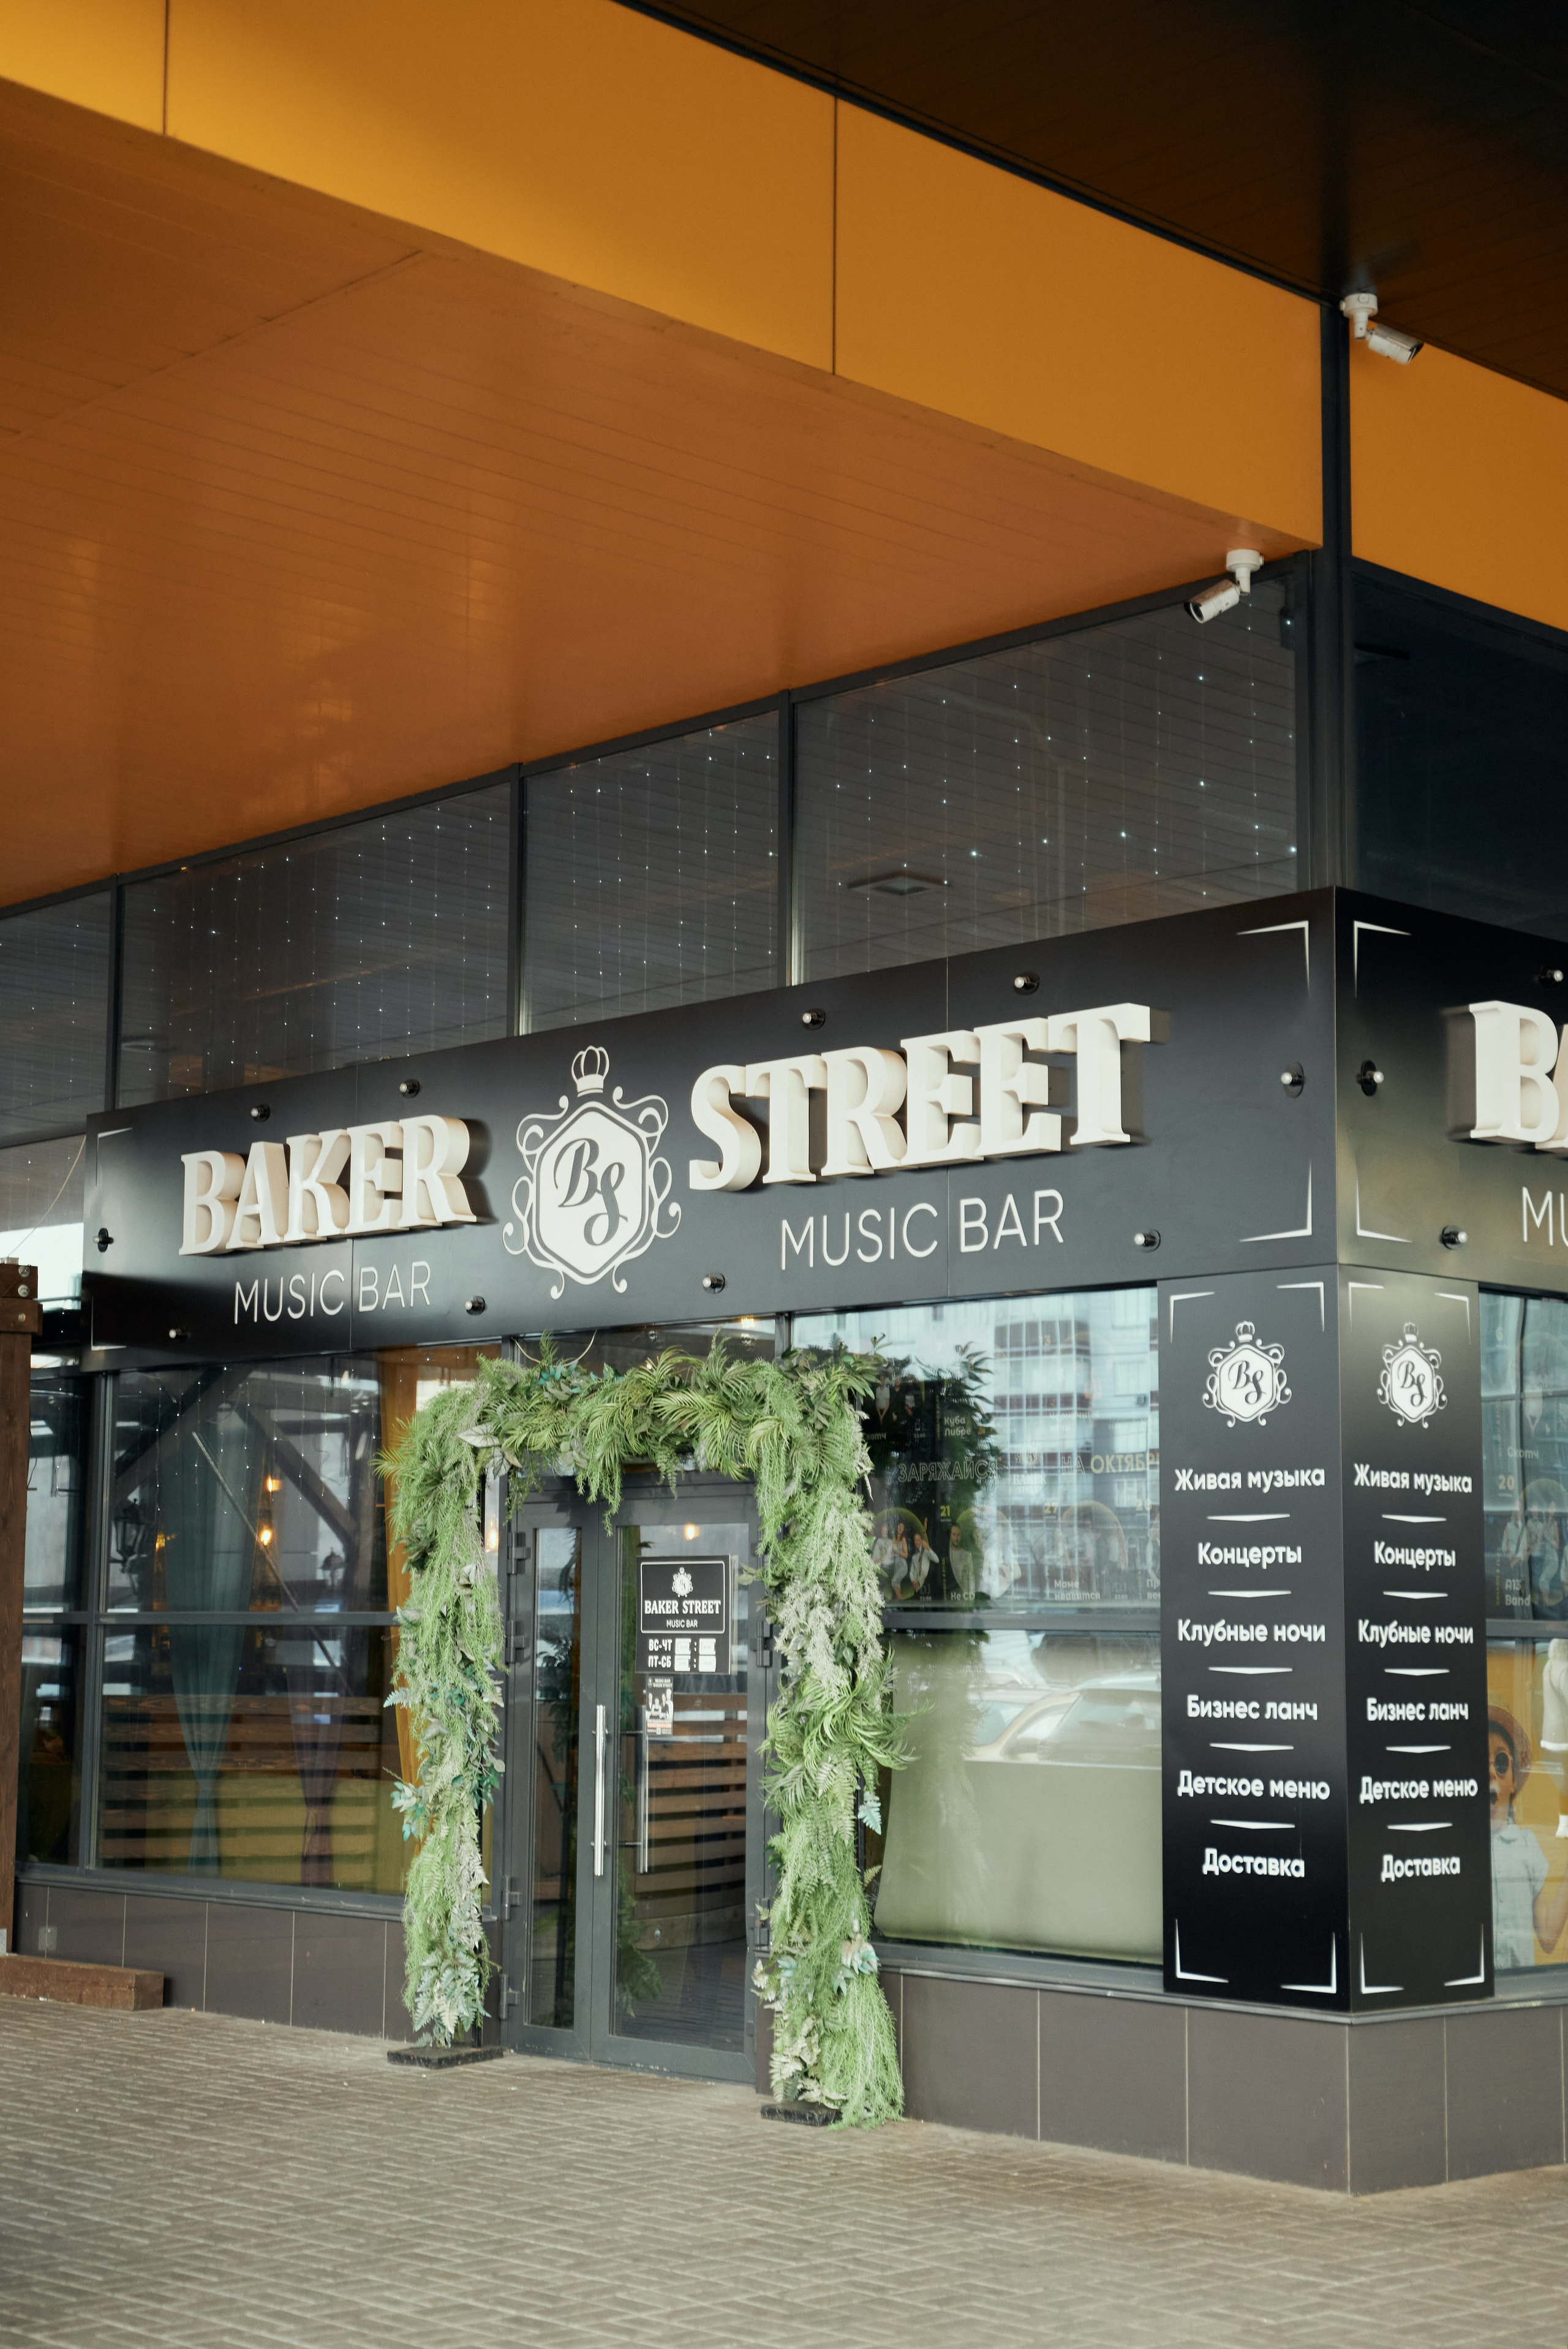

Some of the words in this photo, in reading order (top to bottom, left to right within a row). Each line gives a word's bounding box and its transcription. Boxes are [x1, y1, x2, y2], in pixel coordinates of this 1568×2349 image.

[179, 1114, 477, 1256] BAKER
[689, 1002, 1151, 1192] STREET
[781, 1202, 938, 1271] MUSIC
[959, 1189, 1065, 1254] BAR
[234, 1269, 344, 1325] MUSIC
[358, 1260, 431, 1312] BAR
[944, 1415, 966, 1428] Куба
[1507, 1447, 1539, 1459] Скотч
[898, 1456, 998, 1482] ЗАРЯЖАЙСЯ
[1061, 1455, 1085, 1475] НА
[1013, 1473, 1047, 1485] BAKER
[1174, 1469, 1242, 1491] Живая
[1247, 1468, 1325, 1493] музыка
[1353, 1463, 1410, 1489] Живая
[1414, 1473, 1473, 1496] музыка
[1498, 1475, 1515, 1491] 20
[940, 1505, 951, 1517] 21
[1044, 1502, 1058, 1514] 27
[1197, 1542, 1302, 1570] Концерты
[1374, 1541, 1457, 1572] Концерты
[1054, 1579, 1080, 1589] Маме
[1054, 1591, 1101, 1601] нравится
[644, 1600, 679, 1614] BAKER
[682, 1600, 722, 1614] STREET
[1505, 1594, 1531, 1606] Band
[666, 1619, 685, 1628] MUSIC
[686, 1619, 698, 1628] BAR
[1178, 1619, 1268, 1647] Клубные
[1273, 1624, 1326, 1642] ночи
[1358, 1619, 1431, 1648] Клубные
[1434, 1625, 1474, 1644] ночи
[648, 1638, 673, 1652] ВС-ЧТ
[648, 1655, 672, 1668] ПТ-СБ
[1187, 1694, 1260, 1719] Бизнес
[1264, 1701, 1318, 1720] ланч
[1366, 1697, 1426, 1721] Бизнес
[1428, 1703, 1469, 1721] ланч
[1177, 1770, 1264, 1797] Детское
[1269, 1780, 1330, 1800] меню
[1359, 1776, 1430, 1804] Детское
[1433, 1778, 1479, 1798] меню
[1202, 1848, 1305, 1878] Доставка
[1381, 1854, 1461, 1883] Доставка
